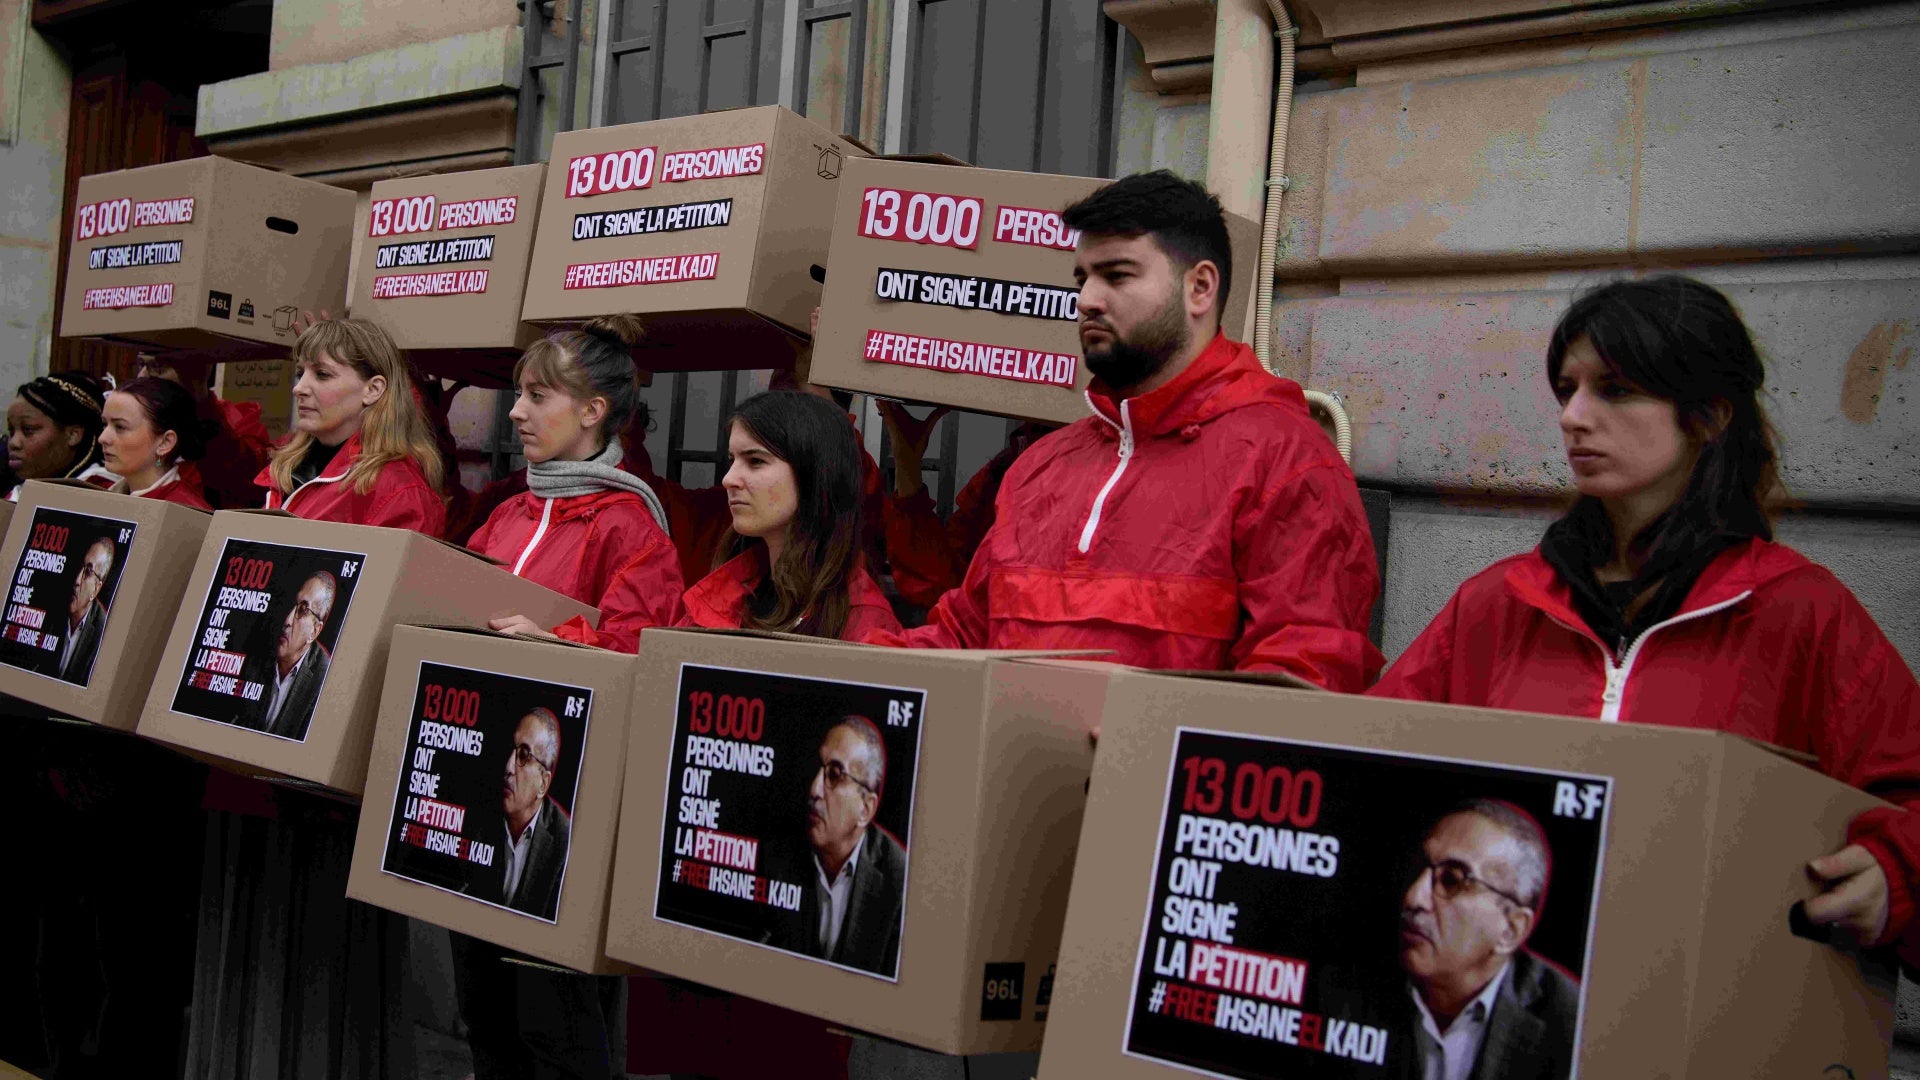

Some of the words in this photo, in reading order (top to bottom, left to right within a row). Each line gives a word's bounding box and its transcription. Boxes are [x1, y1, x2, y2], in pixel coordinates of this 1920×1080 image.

[569, 157, 596, 196] 13
[599, 148, 655, 191] 000
[662, 145, 763, 181] PERSONNES
[79, 204, 96, 238] 13
[98, 199, 130, 235] 000
[134, 199, 193, 226] PERSONNES
[372, 201, 393, 235] 13
[394, 196, 435, 232] 000
[439, 198, 516, 228] PERSONNES
[574, 215, 603, 238] ONT
[604, 208, 646, 236] SIGNÉ
[647, 213, 664, 232] LA
[666, 202, 731, 229] PÉTITION
[864, 190, 900, 237] 13
[905, 194, 981, 246] 000
[997, 208, 1082, 248] PERSO
[90, 251, 106, 268] ONT
[107, 247, 131, 266] SIGNÉ
[132, 249, 142, 265] LA
[143, 242, 181, 264] PÉTITION
[377, 247, 399, 267] ONT
[399, 241, 430, 265] SIGNÉ
[429, 243, 443, 262] LA
[445, 238, 494, 261] PÉTITION
[374, 271, 488, 297] #FREEIHSANEELKADI
[566, 255, 717, 287] #FREEIHSANEELKADI
[84, 284, 173, 308] #FREEIHSANEELKADI
[211, 298, 228, 311] 96L
[877, 271, 918, 300] ONT
[920, 276, 977, 308] SIGNÉ
[979, 282, 1002, 310] LA
[1005, 285, 1080, 319] PÉTITIO
[867, 332, 1076, 385] #FREEIHSANEELKADI
[32, 523, 45, 549] 13
[44, 525, 69, 553] 000
[18, 568, 34, 586] ONT
[24, 549, 66, 574] PERSONNES
[224, 557, 242, 586] 13
[241, 559, 273, 589] 000
[7, 604, 16, 622] LA
[209, 608, 231, 627] ONT
[216, 587, 271, 613] PERSONNES
[203, 628, 231, 649] SIGNÉ
[195, 649, 207, 668] LA
[205, 651, 246, 675] PÉTITION
[423, 684, 442, 721] 13
[442, 688, 480, 727] 000
[688, 691, 712, 735] 13
[716, 696, 765, 742] 000
[418, 721, 484, 756] PERSONNES
[686, 735, 774, 777] PERSONNES
[414, 747, 435, 772] ONT
[409, 771, 441, 798] SIGNÉ
[682, 766, 712, 797] ONT
[1183, 756, 1227, 816] 13
[1231, 762, 1323, 828] 000
[404, 796, 418, 821] LA
[417, 799, 465, 833] PÉTITION
[679, 795, 721, 830] SIGNÉ
[400, 823, 494, 867] #FREEIHSANEELKADI
[674, 826, 694, 857] LA
[694, 830, 758, 871] PÉTITION
[1174, 814, 1340, 878] PERSONNES
[672, 859, 802, 912] #FREEIHSANEELKADI
[1168, 858, 1222, 899] ONT
[1161, 895, 1239, 945] SIGNÉ
[1153, 937, 1188, 979] LA
[1189, 945, 1307, 1004] PÉTITION
[986, 980, 1018, 1000] 96L
[1148, 980, 1388, 1066] #FREEIHSANEELKADI
